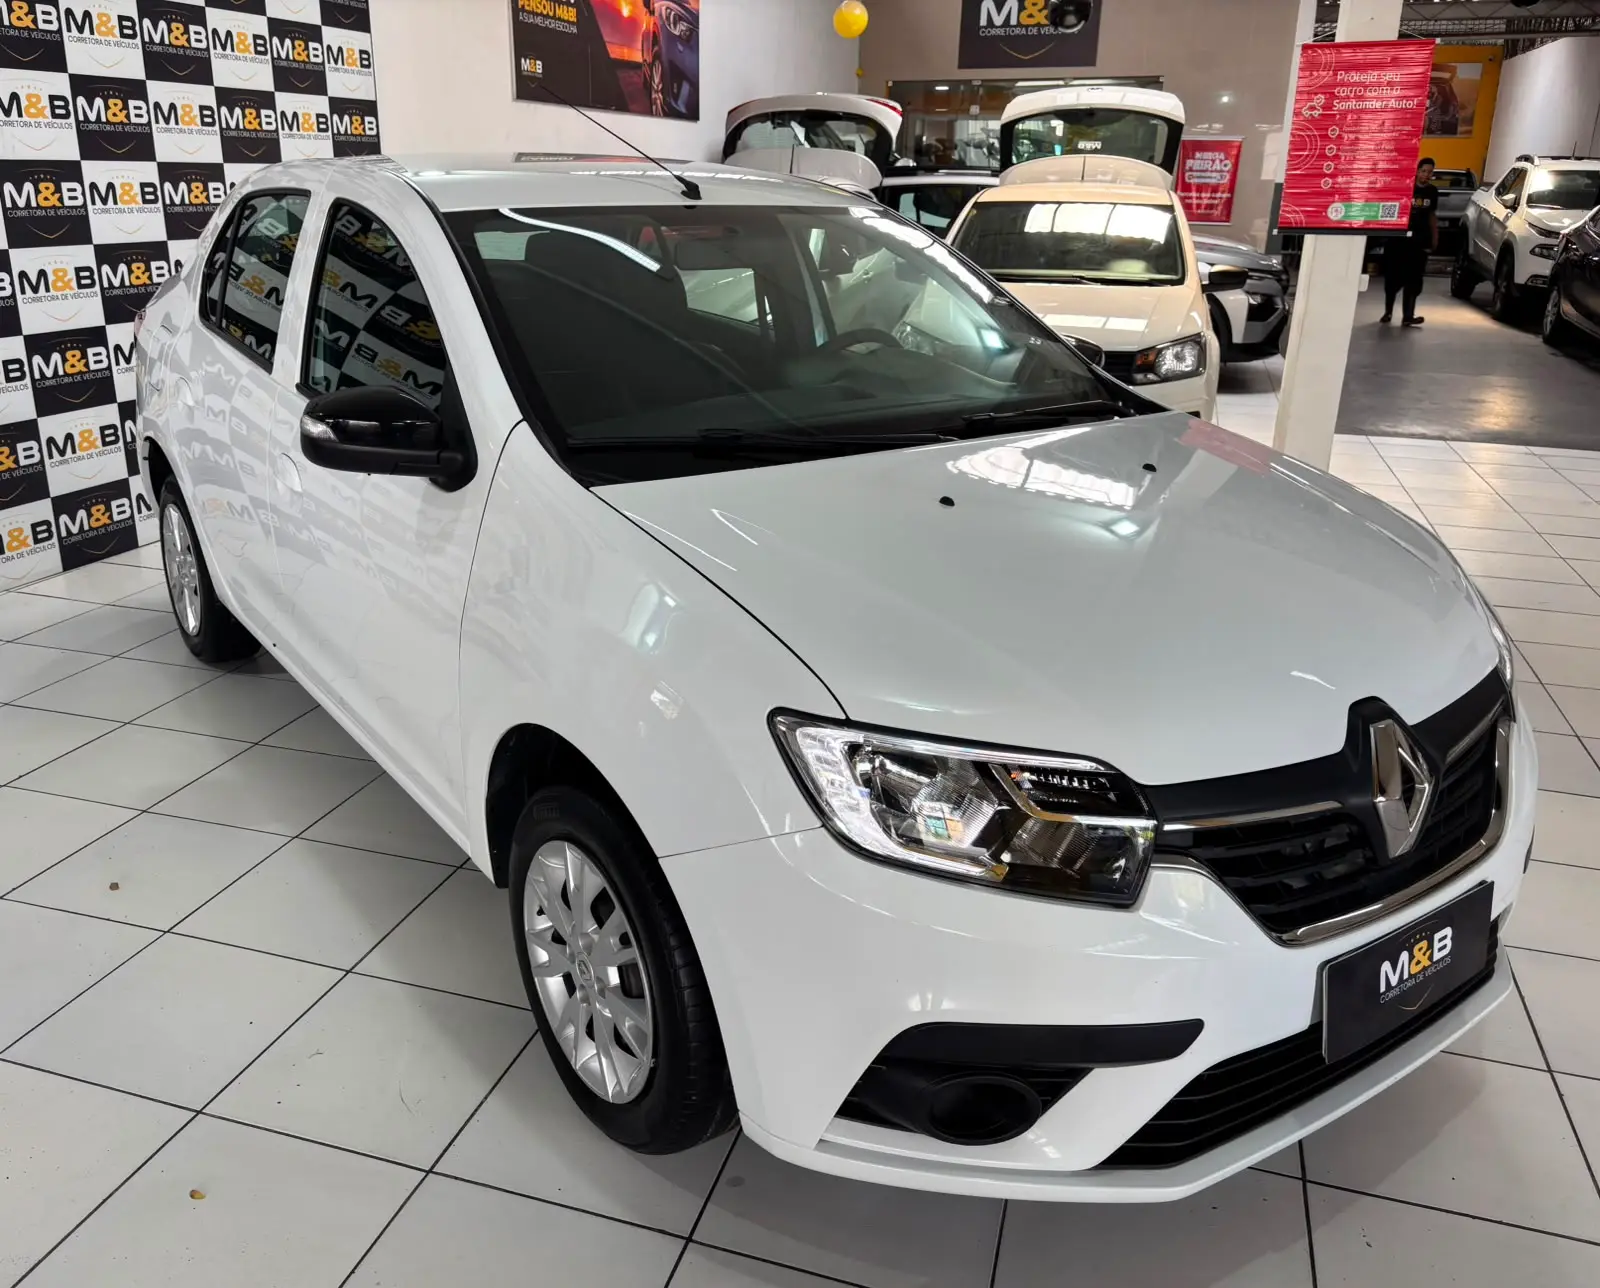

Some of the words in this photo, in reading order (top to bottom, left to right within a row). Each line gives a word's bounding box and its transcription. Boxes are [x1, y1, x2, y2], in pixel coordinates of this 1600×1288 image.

[64, 7, 138, 40] M&B
[524, 12, 534, 24] SUA
[534, 15, 555, 28] MELHOR
[556, 20, 577, 33] ESCOLHA
[556, 3, 577, 22] M&B!
[980, 0, 1056, 26] M&
[68, 35, 103, 46] CORRETORA
[142, 18, 208, 49] M&B
[211, 28, 268, 56] M&B
[980, 27, 1026, 36] CORRETORA
[1028, 27, 1037, 35] DE
[146, 44, 177, 54] CORRETORA
[272, 36, 323, 63] M&B
[326, 44, 371, 69] M&B
[521, 57, 542, 73] M&B
[1337, 71, 1377, 84] Proteja
[1381, 72, 1400, 81] seu
[1335, 87, 1364, 97] carro
[1367, 87, 1390, 95] com
[76, 96, 149, 124] M&B
[153, 101, 216, 127] M&B
[1333, 100, 1385, 110] Santander
[1389, 99, 1416, 108] Auto!
[0, 120, 33, 128] ORRETORA
[80, 123, 115, 132] CORRETORA
[220, 106, 276, 131] M&B
[280, 110, 329, 133] M&B
[332, 114, 377, 135] M&B
[156, 127, 186, 135] CORRETORA
[3, 182, 84, 208] M&B
[89, 181, 160, 206] M&B
[163, 181, 227, 205] M&B
[8, 209, 46, 217] CORRETORA
[93, 207, 127, 215] CORRETORA
[18, 266, 96, 295] M&B
[101, 260, 170, 288] M&B
[22, 295, 60, 304] CORRETORA
[32, 346, 109, 379] M&B
[36, 375, 73, 388] CORRETORA
[74, 374, 82, 382] DE
[46, 424, 120, 460] M&B
[0, 440, 41, 472] &B
[50, 455, 85, 468] CORRETORA
[2, 472, 11, 480] DE
[59, 498, 132, 538] M&B
[0, 520, 54, 555] &B
[62, 531, 98, 545] CORRETORA
[1380, 926, 1452, 994] M&B
[1380, 978, 1415, 1004] CORRETORA
[1416, 972, 1424, 982] DE
